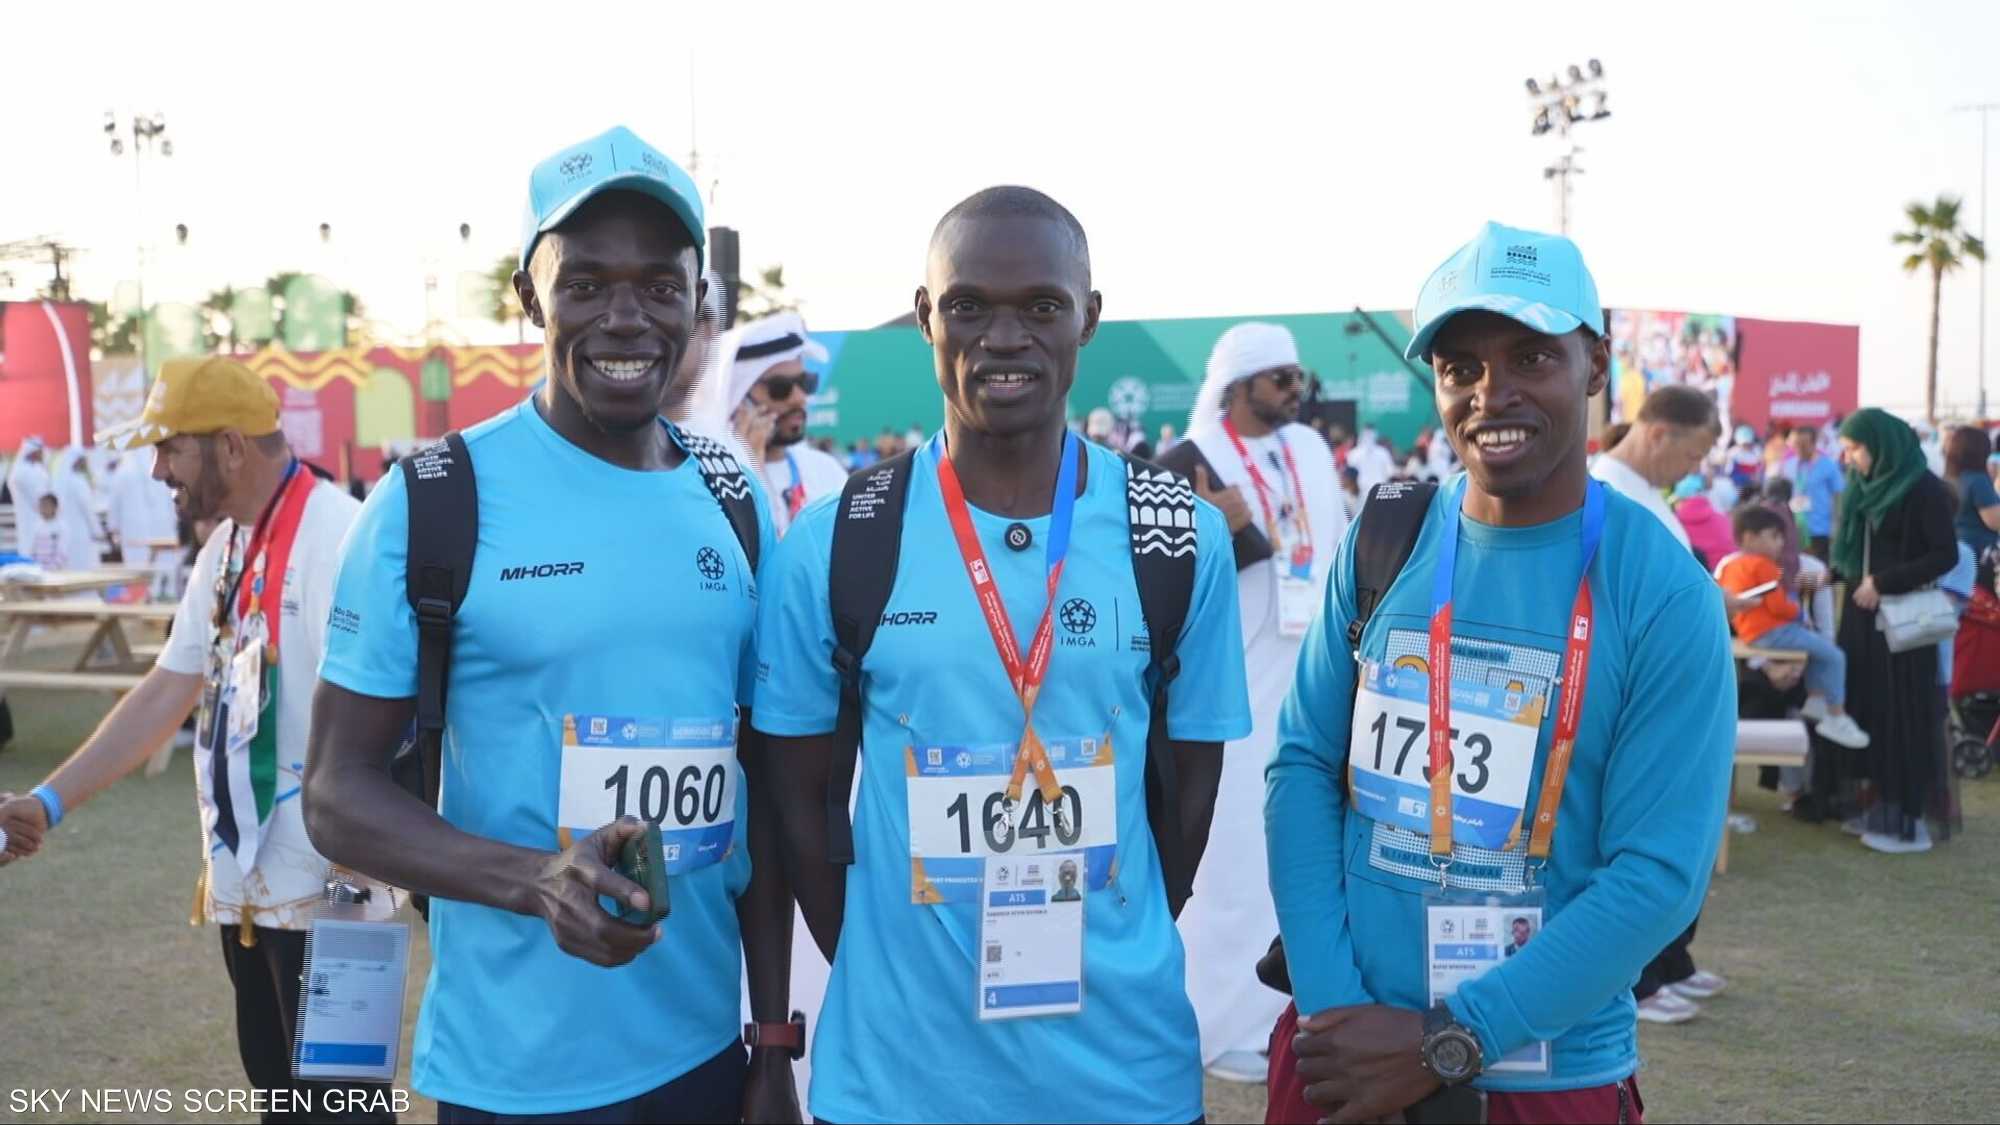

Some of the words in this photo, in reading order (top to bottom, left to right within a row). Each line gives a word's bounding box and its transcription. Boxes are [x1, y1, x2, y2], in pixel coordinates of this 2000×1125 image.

[500, 561, 584, 582] MHORR
[700, 582, 728, 592] IMGA
[880, 611, 938, 627] HORR
[1060, 636, 1096, 648] IMGA
[604, 763, 726, 826] 1060
[946, 785, 1083, 854] 1640
[1008, 893, 1026, 903] ATS
[1456, 946, 1476, 956] ATS
[987, 992, 997, 1006] 4
